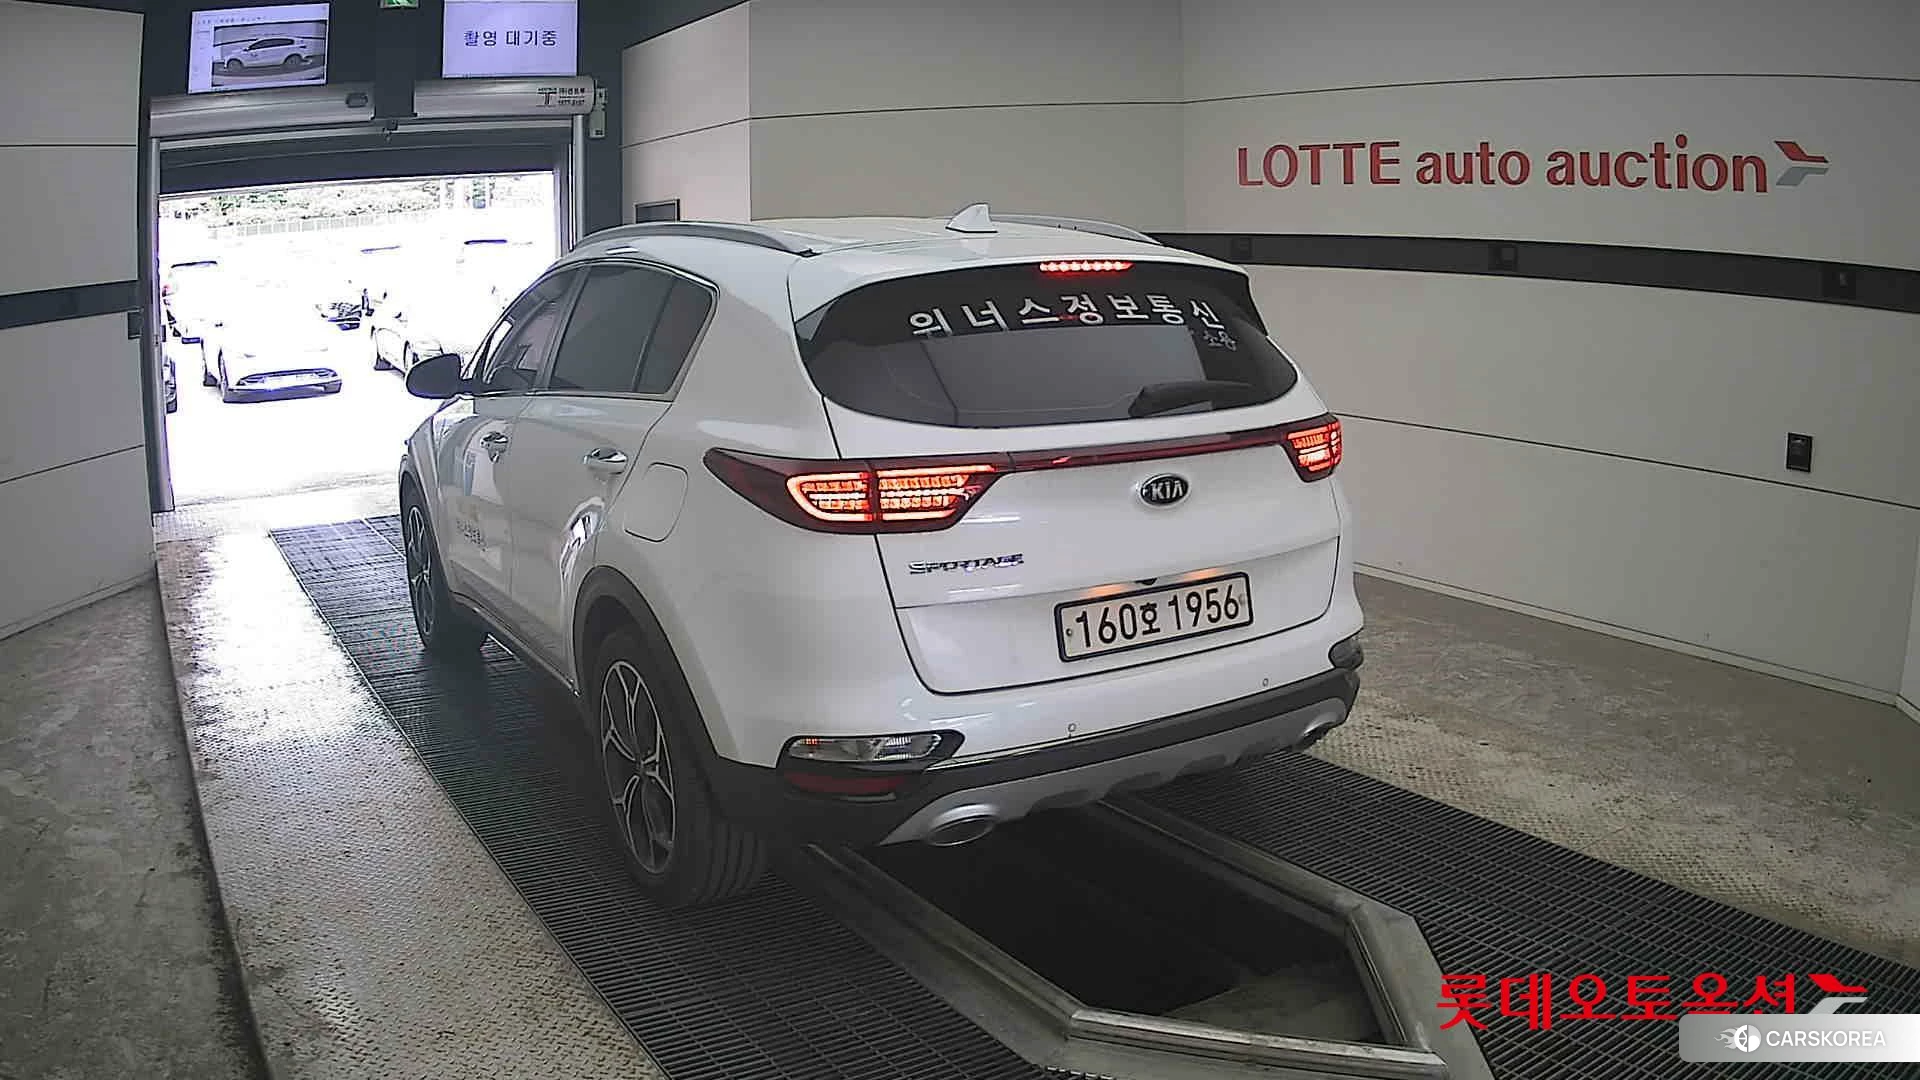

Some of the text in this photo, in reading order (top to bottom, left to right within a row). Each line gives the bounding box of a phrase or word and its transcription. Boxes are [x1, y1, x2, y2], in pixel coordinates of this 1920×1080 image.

[506, 30, 557, 47] 대기중
[1237, 133, 1768, 193] LOTTE auto auction
[1150, 480, 1183, 501] KIA
[1075, 584, 1240, 648] 160호 1956
